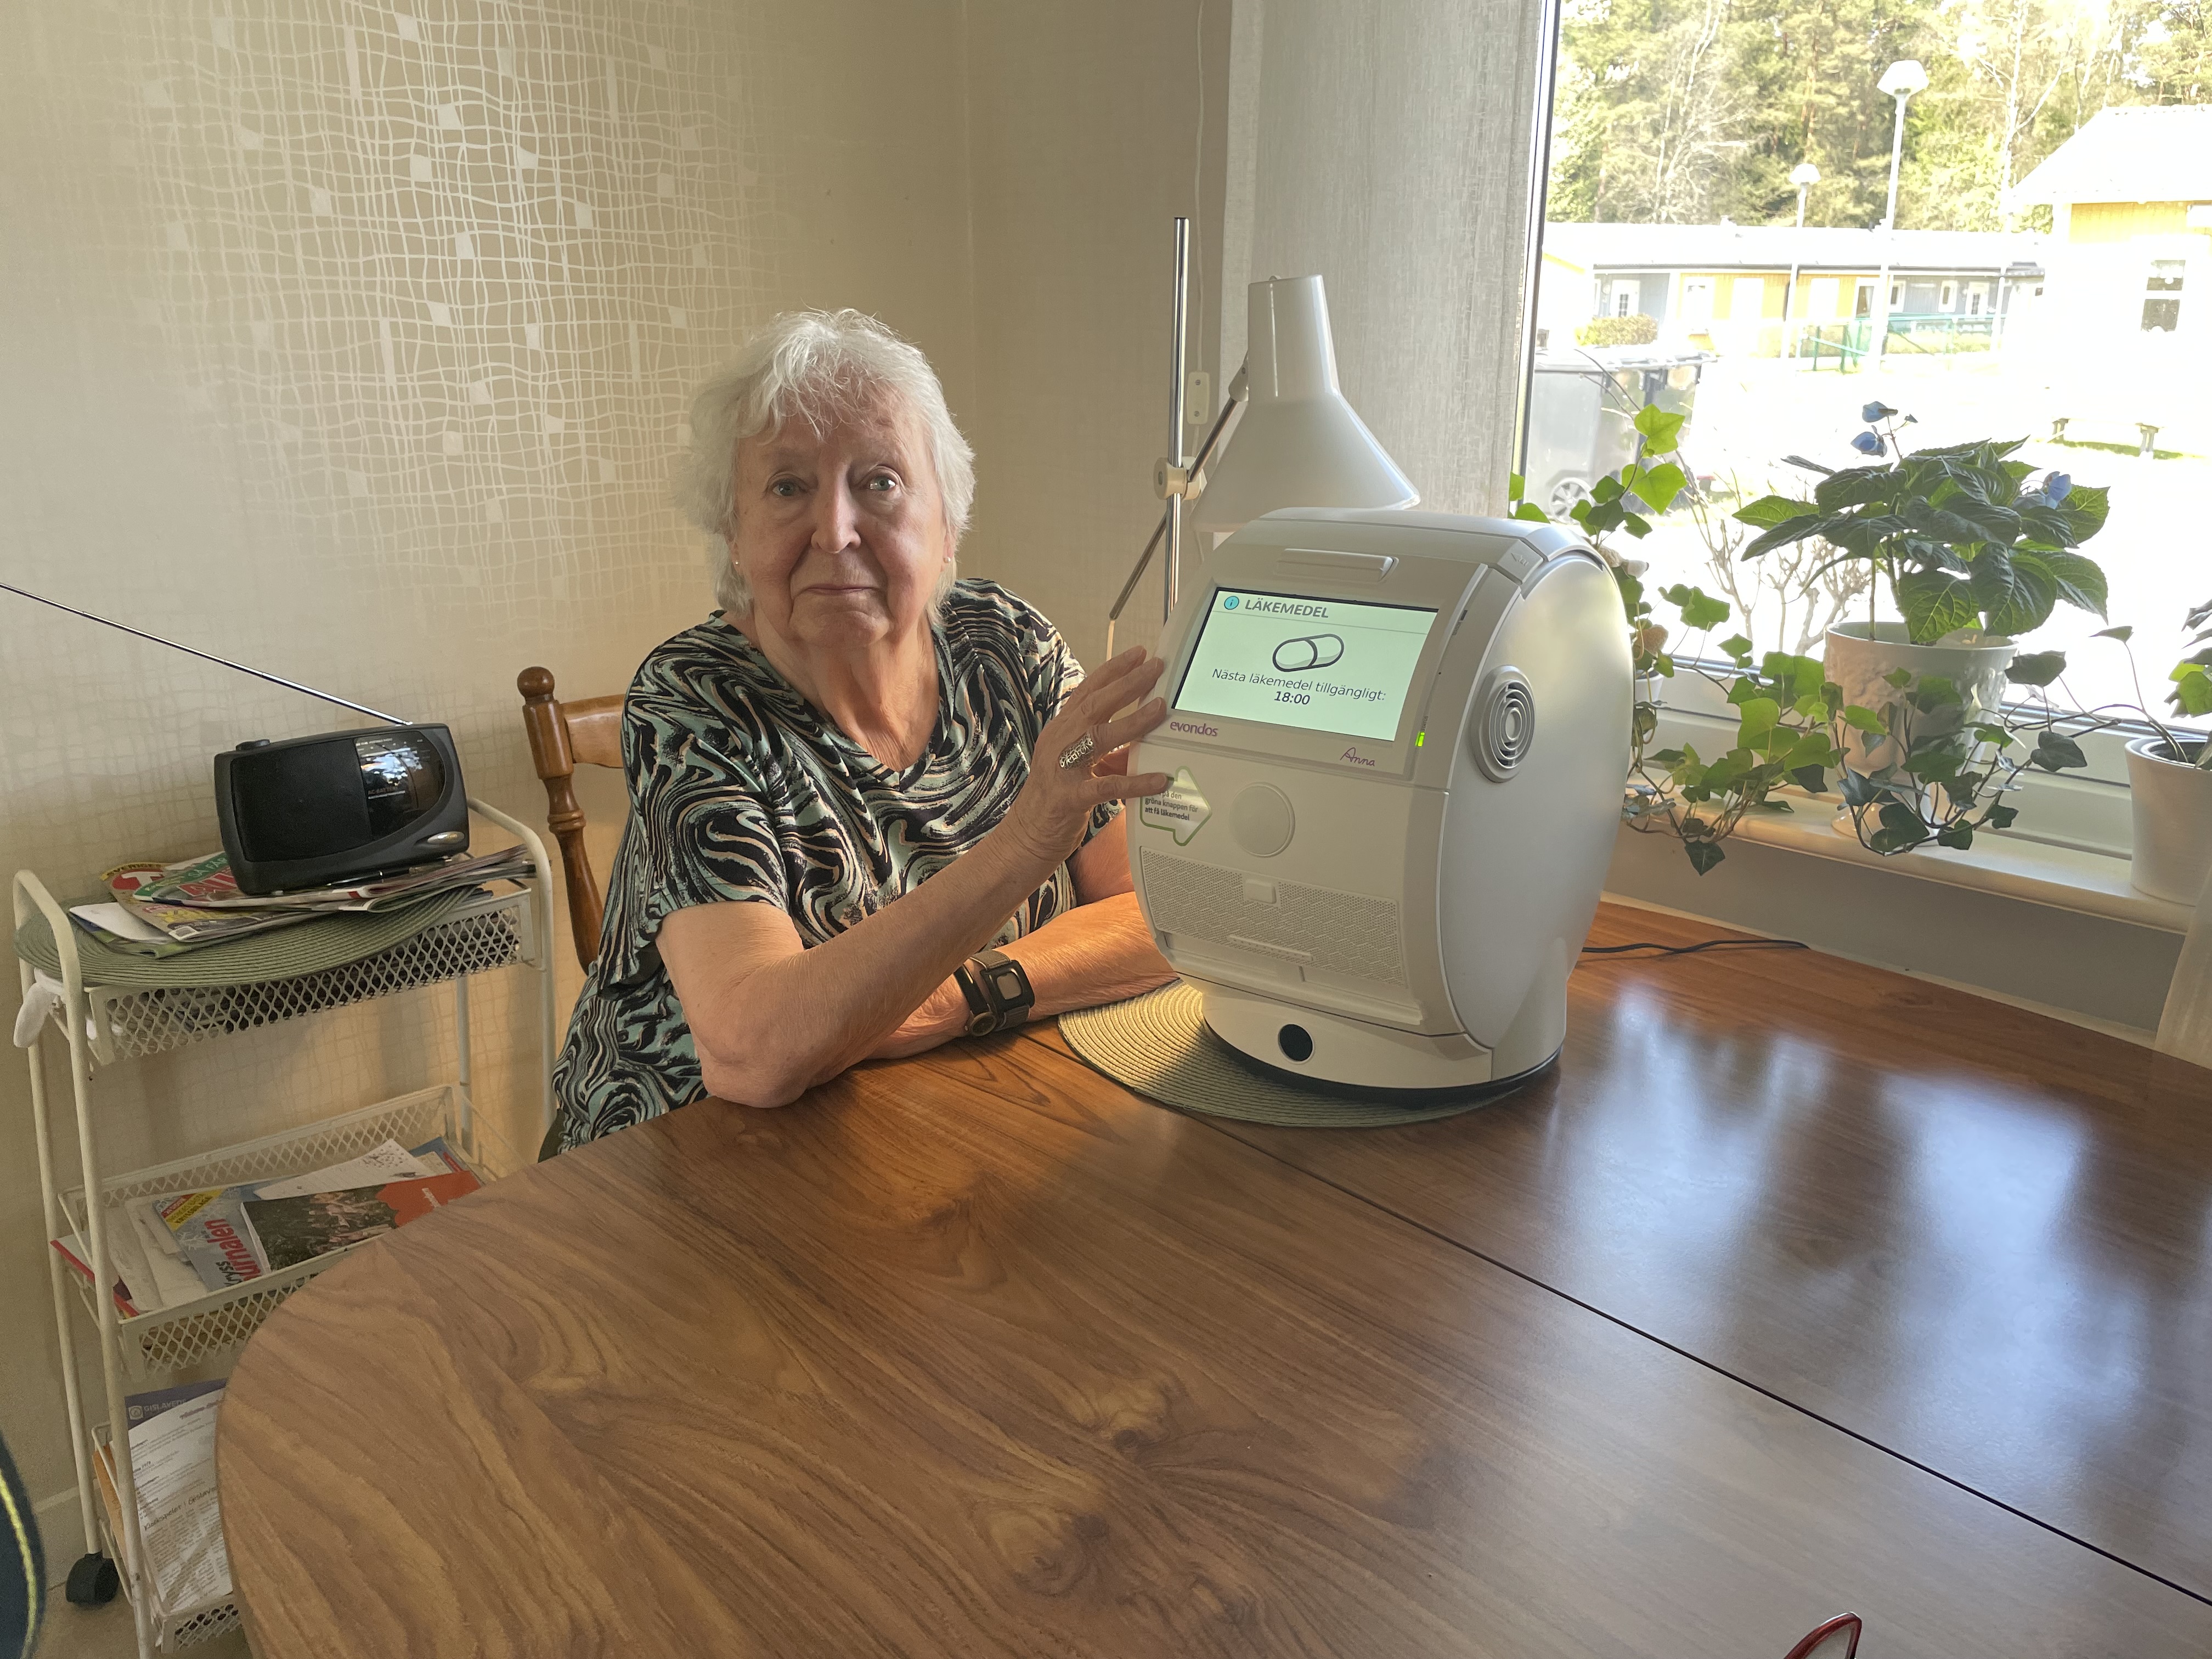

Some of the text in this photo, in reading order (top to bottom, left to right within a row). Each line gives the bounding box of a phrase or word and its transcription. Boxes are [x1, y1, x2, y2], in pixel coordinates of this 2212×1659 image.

[1245, 597, 1329, 619] LÄKEMEDEL
[1212, 668, 1386, 702] Nästa läkemedel tillgängligt:
[1274, 691, 1311, 706] 18:00
[1170, 720, 1218, 737] evondos
[1340, 747, 1375, 767] Anna
[1163, 800, 1188, 811] knappen
[1189, 804, 1199, 812] för
[1160, 809, 1190, 821] läkemedel
